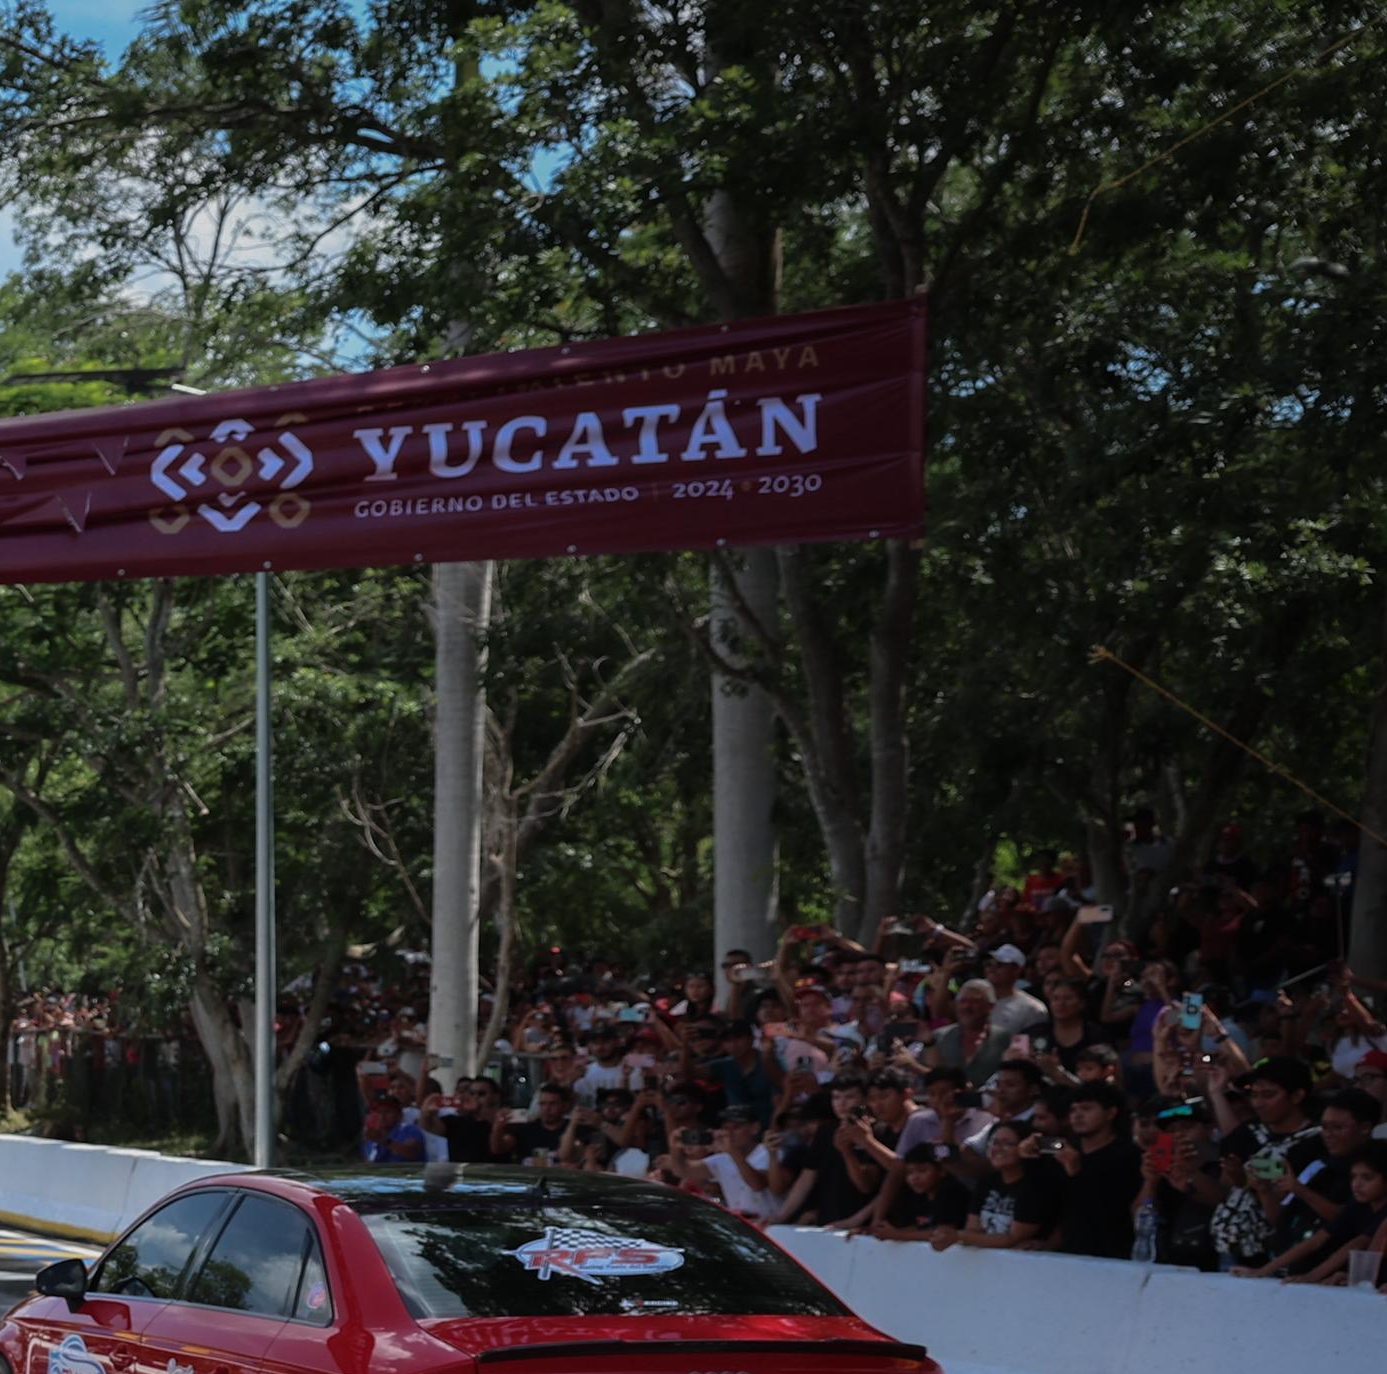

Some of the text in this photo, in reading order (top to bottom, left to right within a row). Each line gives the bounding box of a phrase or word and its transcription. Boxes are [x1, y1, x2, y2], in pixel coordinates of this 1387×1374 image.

[709, 346, 820, 376] MAYA
[353, 388, 823, 482] YUCATÁN
[354, 473, 823, 518] GOBIERNO DEL ESTADO 2024 2030
